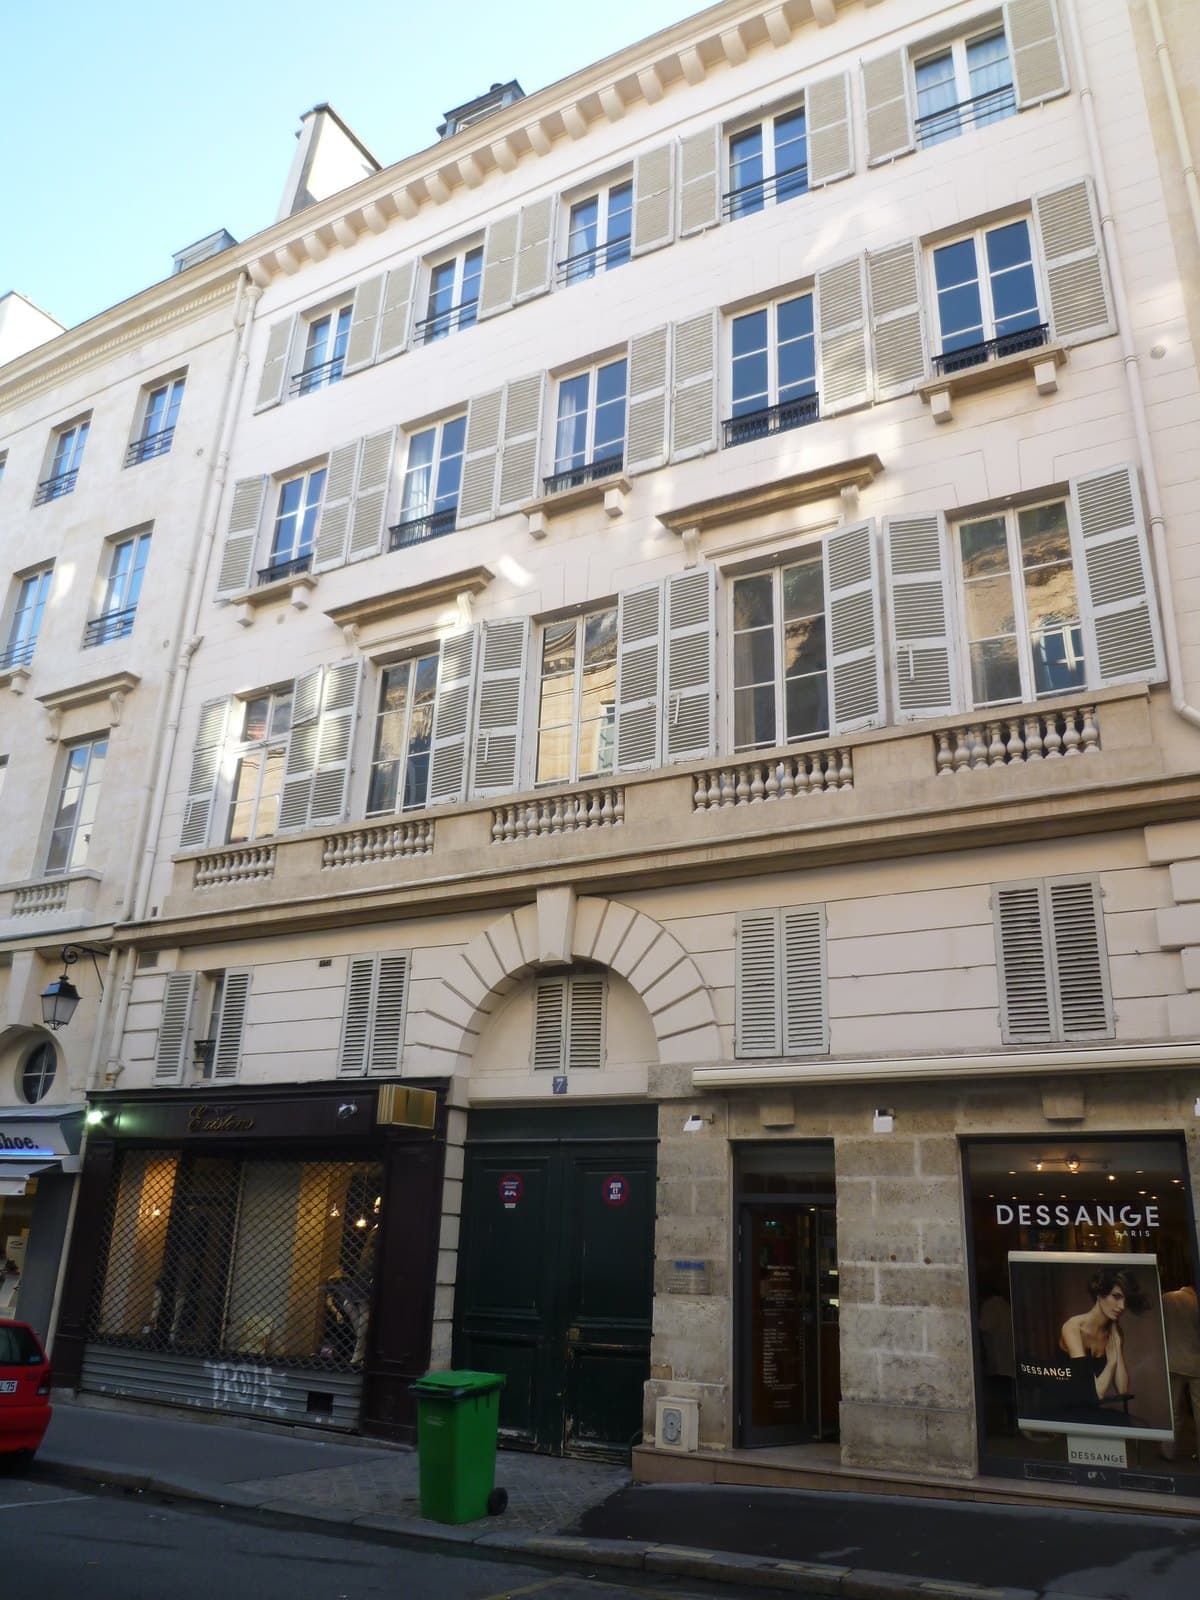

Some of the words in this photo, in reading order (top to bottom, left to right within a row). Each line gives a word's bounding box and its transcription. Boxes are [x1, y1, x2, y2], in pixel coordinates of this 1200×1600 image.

[556, 1078, 564, 1092] 7
[0, 1132, 40, 1149] hoe.
[996, 1204, 1160, 1227] DESSANGE
[1114, 1230, 1151, 1238] PARIS
[1020, 1363, 1072, 1377] DESSANGE
[1070, 1451, 1125, 1464] DESSANGE
